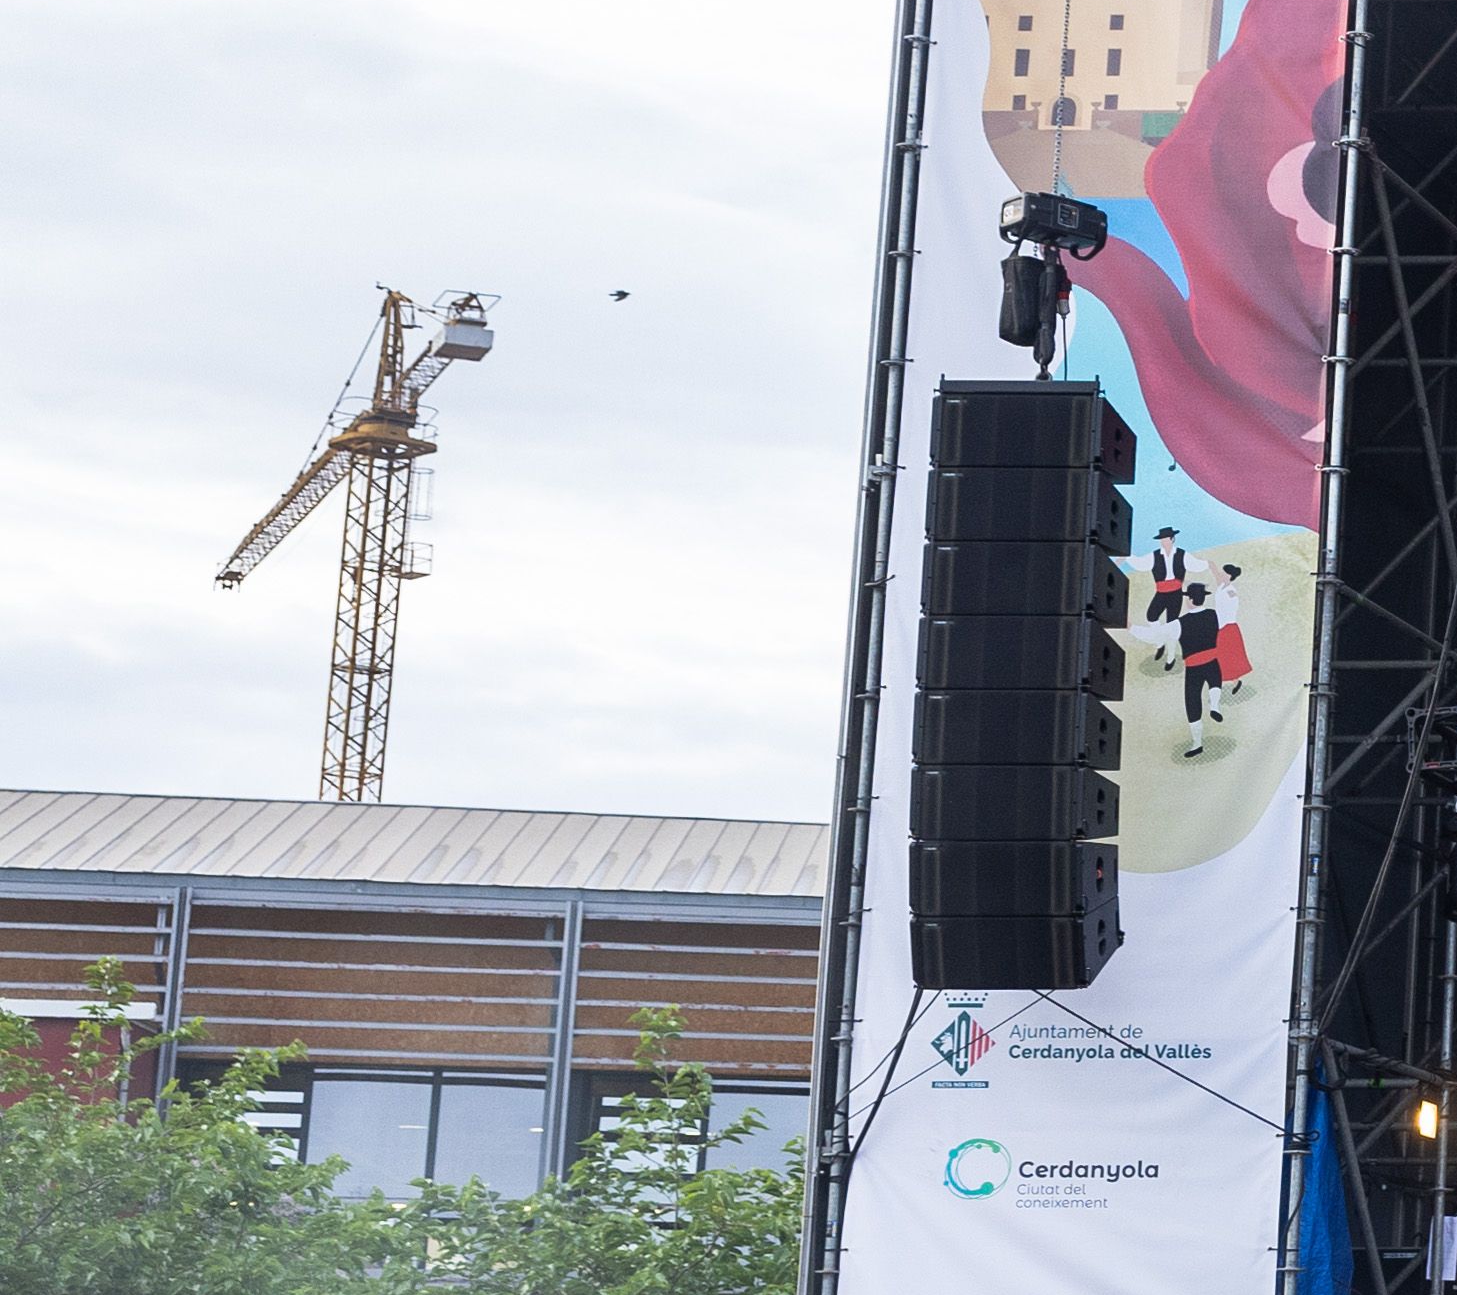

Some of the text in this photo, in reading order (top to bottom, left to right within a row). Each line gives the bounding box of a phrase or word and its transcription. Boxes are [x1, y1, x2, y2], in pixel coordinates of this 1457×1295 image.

[1009, 1024, 1143, 1042] Ajuntament de
[1009, 1043, 1212, 1063] Cerdanyola del Vallès
[1018, 1160, 1159, 1183] Cerdanyola
[1016, 1183, 1086, 1196] Ciutat del
[1016, 1197, 1108, 1209] coneixement
